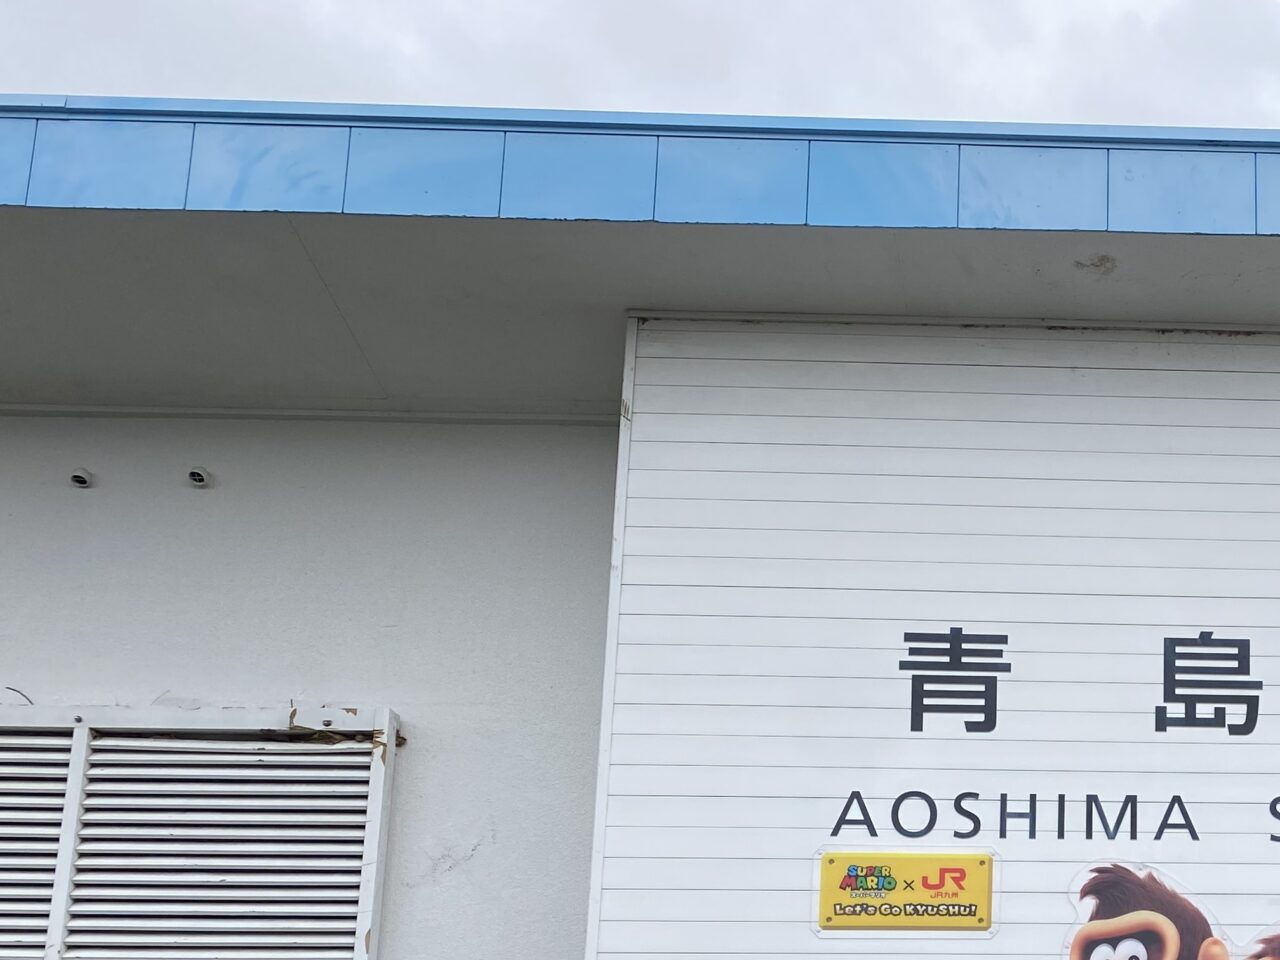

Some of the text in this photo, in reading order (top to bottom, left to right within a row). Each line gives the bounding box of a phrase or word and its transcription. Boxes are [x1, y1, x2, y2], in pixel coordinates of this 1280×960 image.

[831, 791, 1200, 841] AOSHIMA
[847, 865, 892, 877] SUPER
[922, 868, 966, 890] JR
[839, 875, 898, 891] MARIO
[833, 903, 877, 916] Let's
[879, 903, 902, 916] Go
